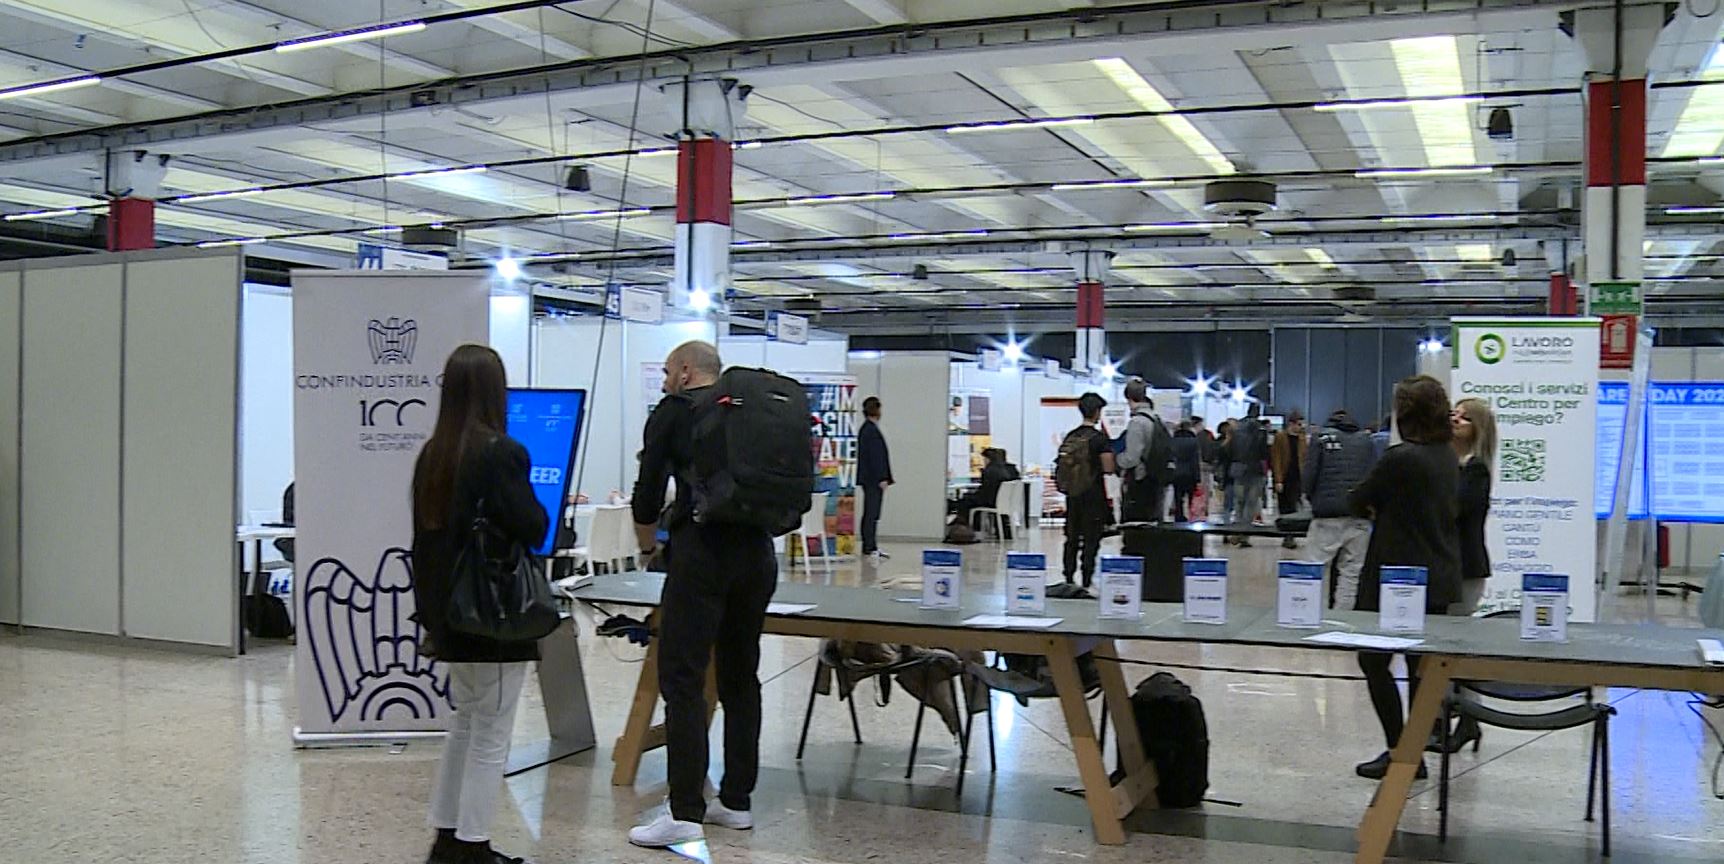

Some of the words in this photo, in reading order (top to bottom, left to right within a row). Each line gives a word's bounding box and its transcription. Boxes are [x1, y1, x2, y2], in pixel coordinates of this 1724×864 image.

[1512, 336, 1574, 347] LAVORO
[297, 375, 431, 389] CONFINDUSTRIA
[1461, 381, 1525, 394] Conosci
[1537, 383, 1589, 395] servizi
[1597, 388, 1629, 402] ARE
[1652, 388, 1688, 402] DAY
[1692, 388, 1724, 402] 202
[1497, 396, 1549, 409] Centro
[1554, 400, 1581, 411] per
[1495, 412, 1564, 426] mpiego?
[530, 466, 561, 484] EER
